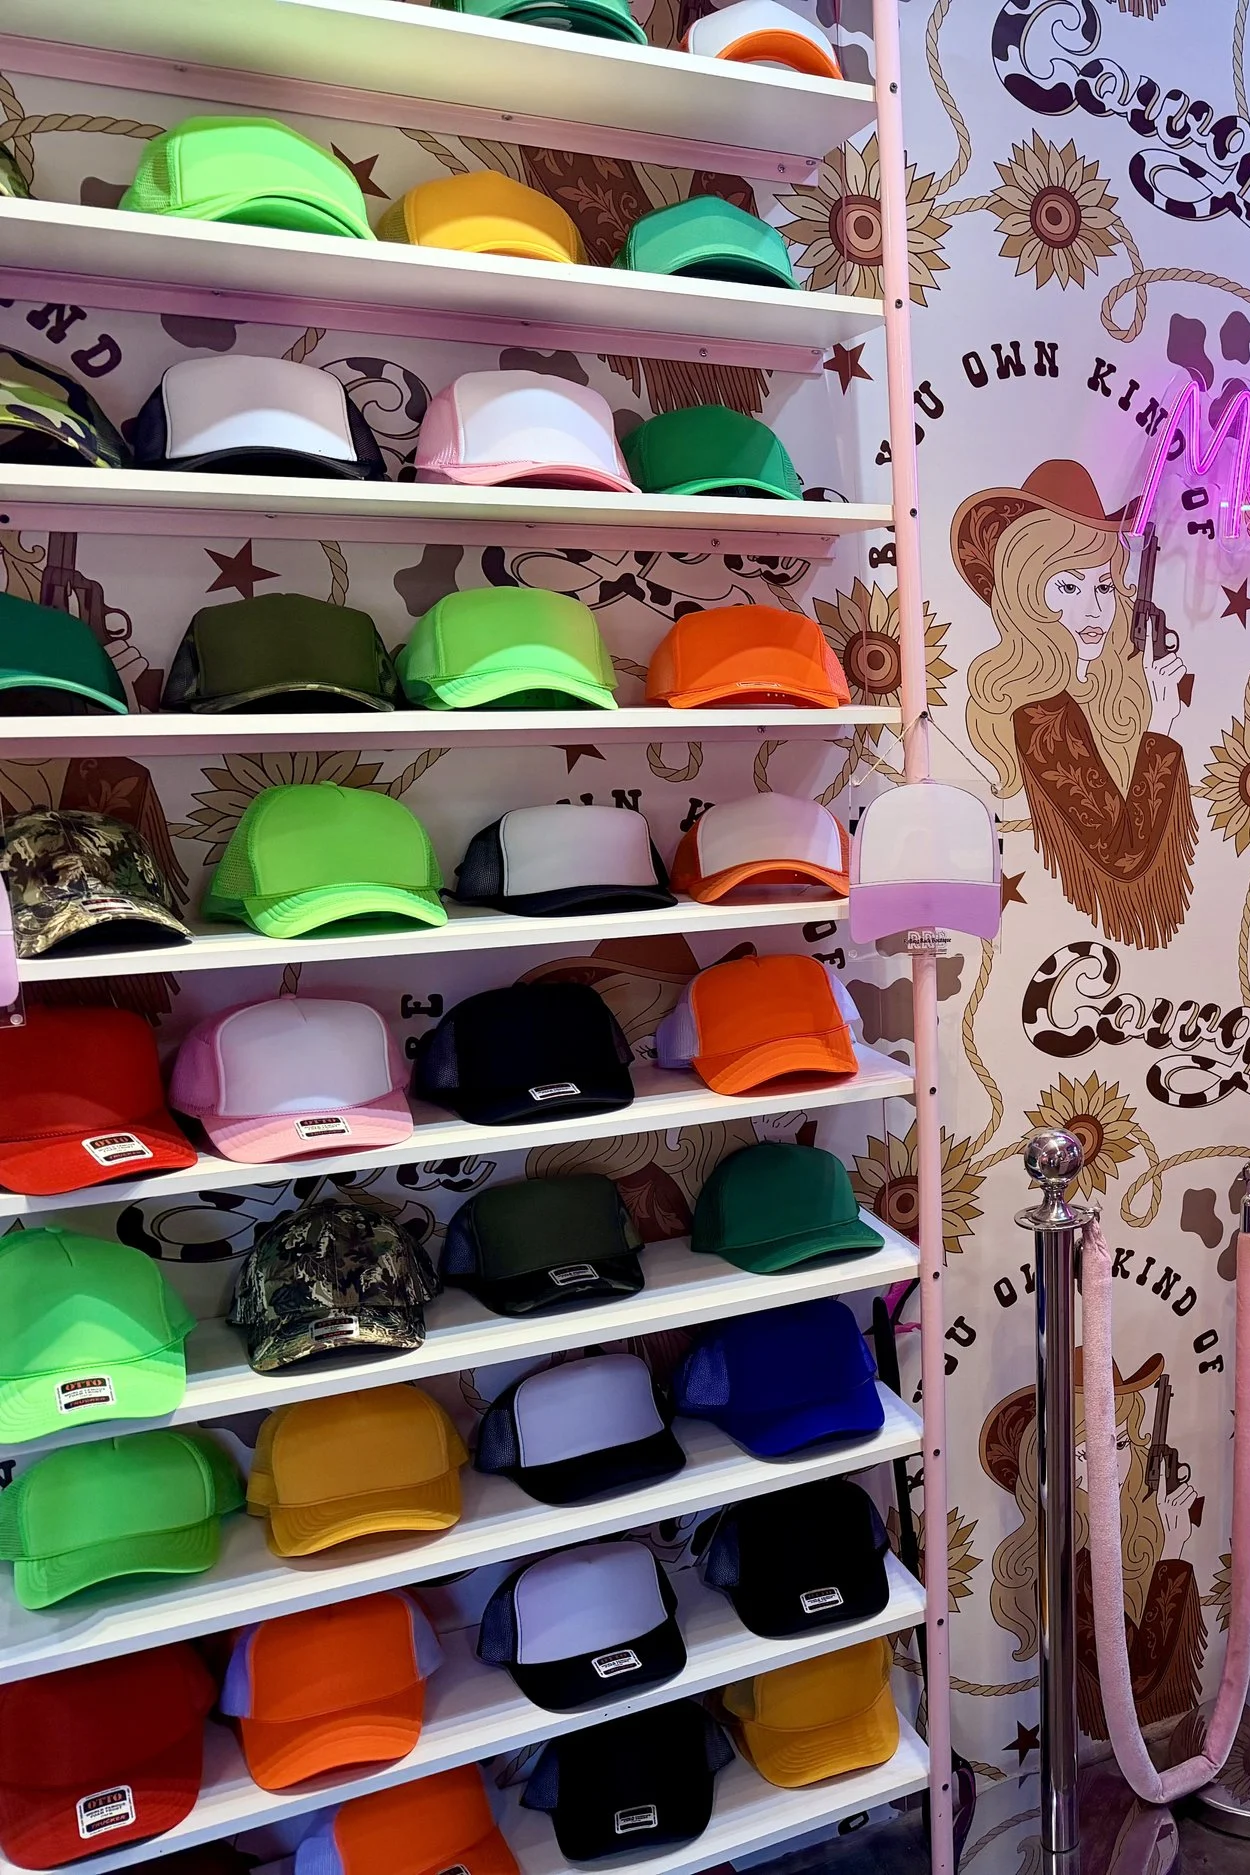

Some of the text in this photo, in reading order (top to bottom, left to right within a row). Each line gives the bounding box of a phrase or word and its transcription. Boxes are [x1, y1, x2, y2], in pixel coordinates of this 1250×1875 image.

[962, 340, 1060, 389] OWN
[1087, 357, 1188, 462] KIND
[1181, 487, 1216, 541] OF
[1193, 1329, 1225, 1375] OF
[87, 1793, 123, 1809] OTTO
